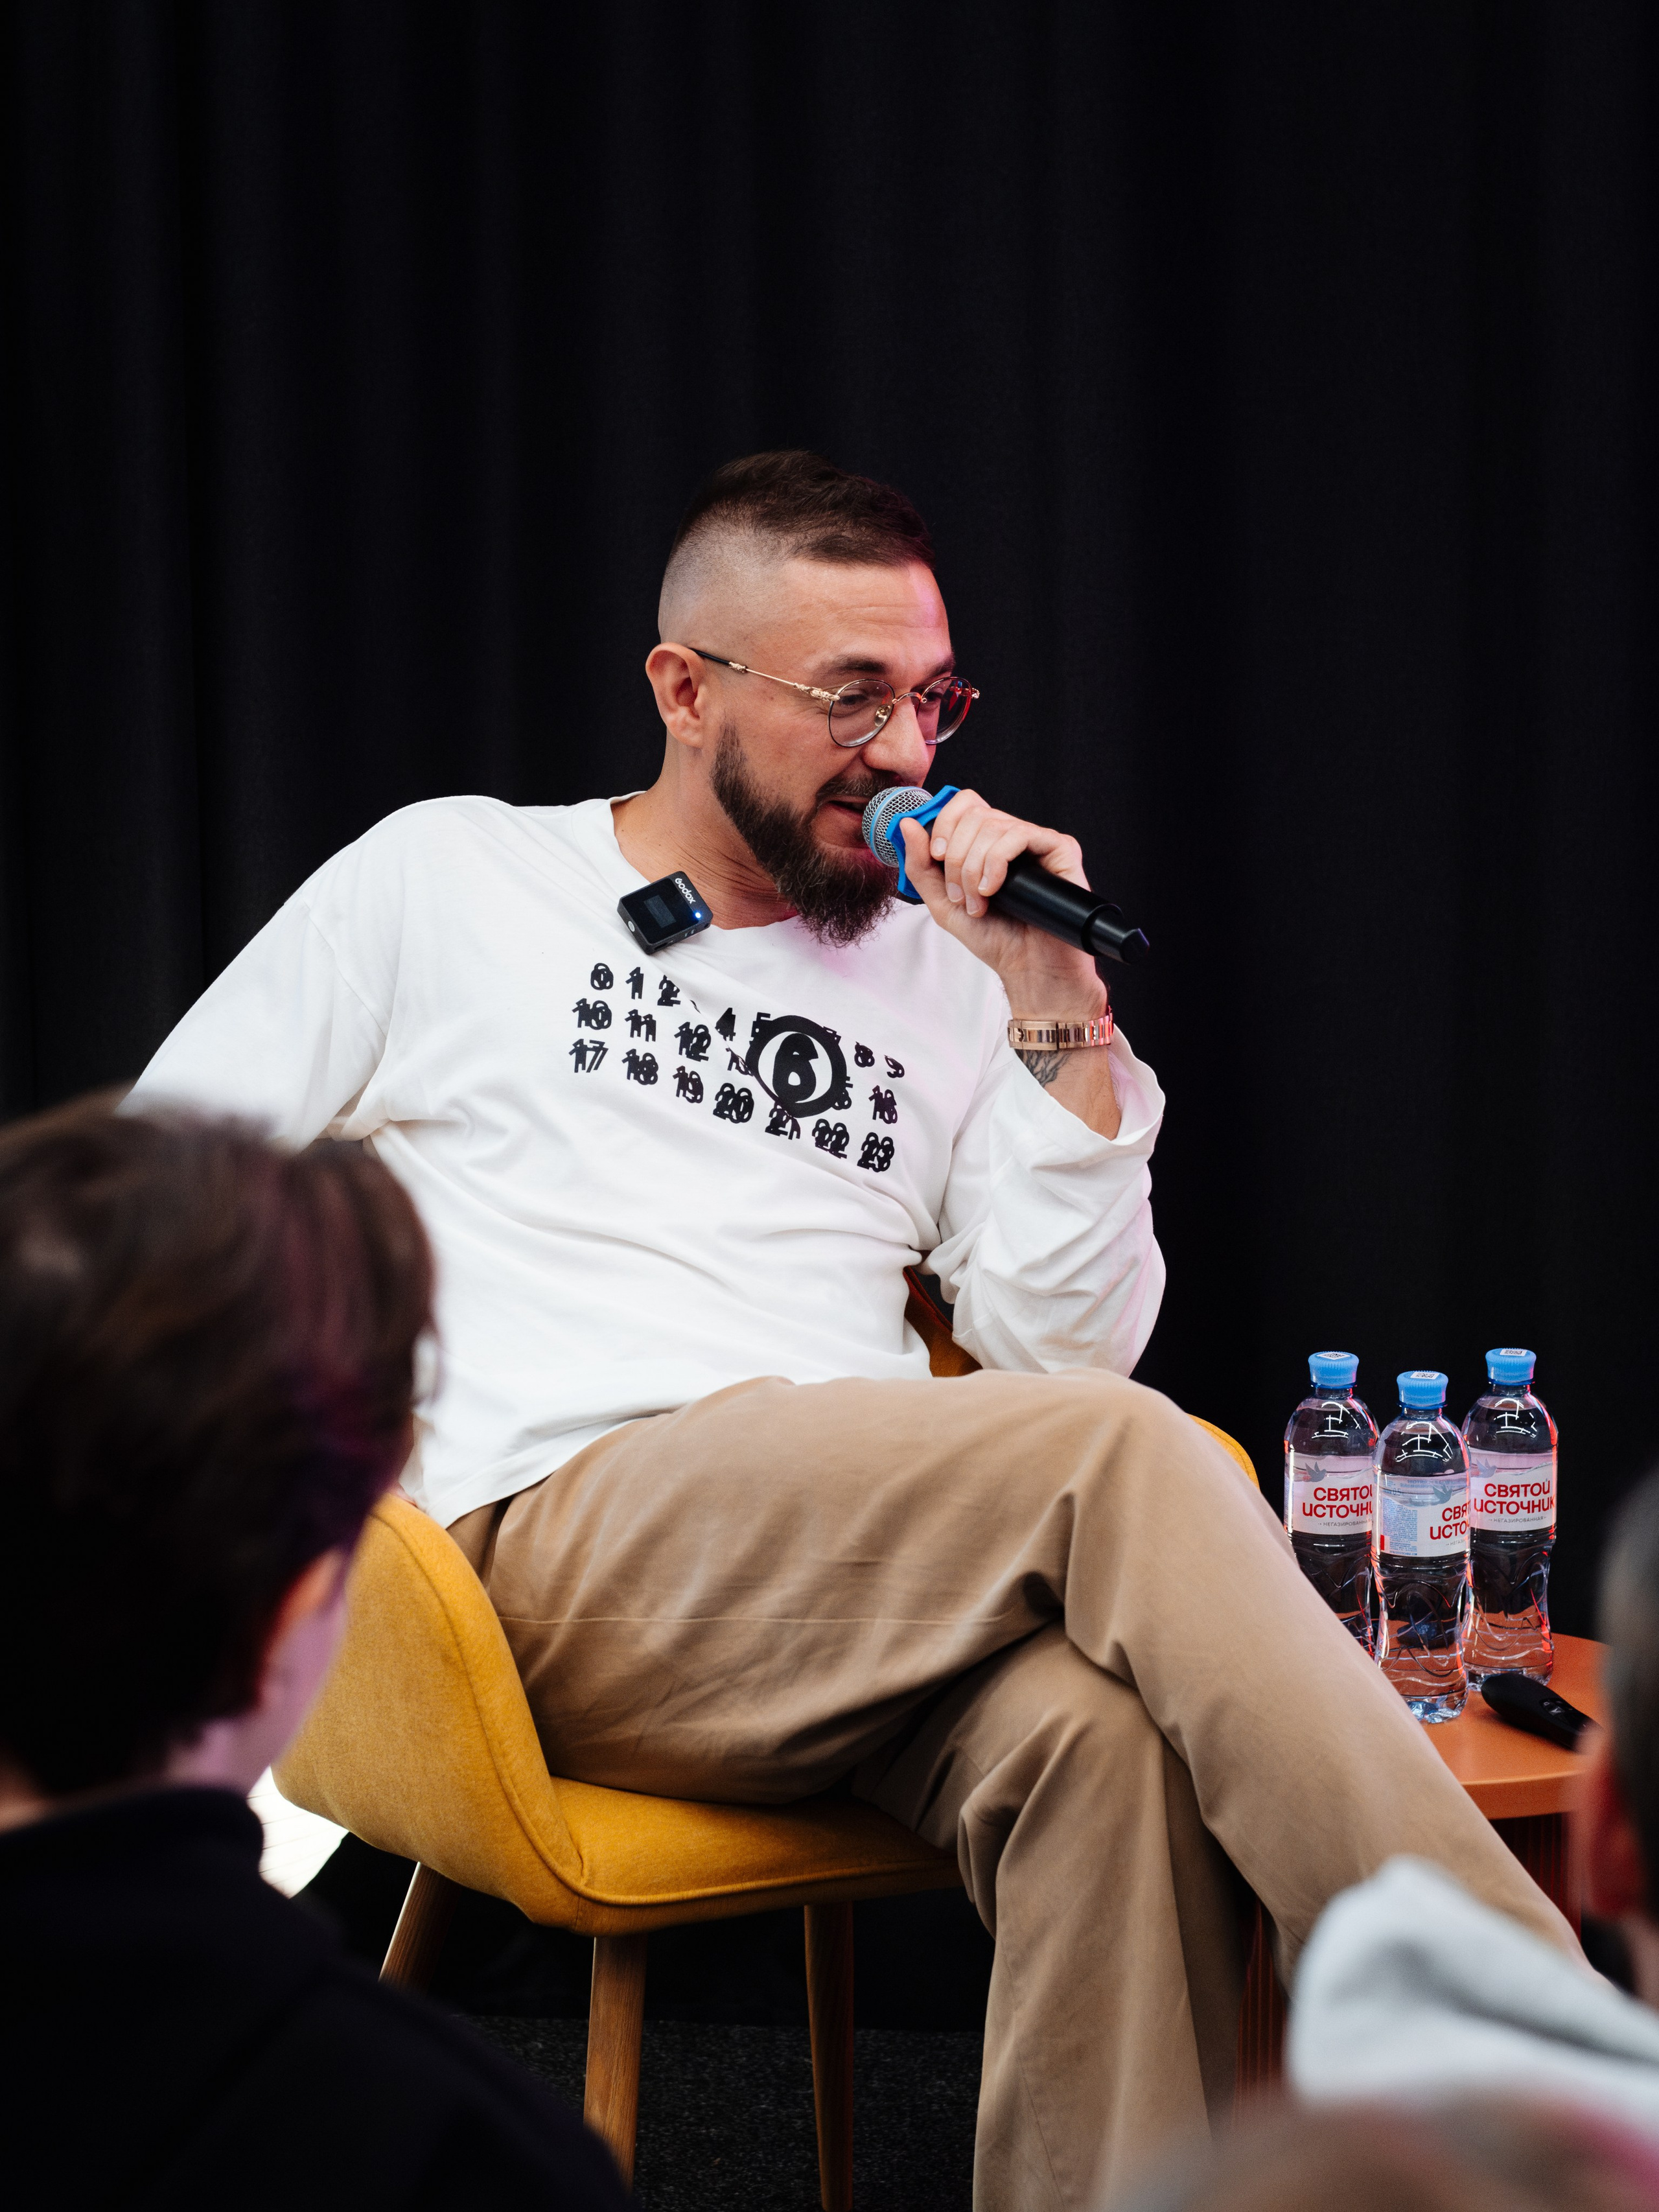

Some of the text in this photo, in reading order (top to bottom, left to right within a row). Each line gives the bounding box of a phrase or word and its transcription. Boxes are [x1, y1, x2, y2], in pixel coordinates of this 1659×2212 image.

[675, 878, 696, 904] Godox
[572, 998, 612, 1030] 10
[625, 1008, 656, 1042] 11
[674, 1021, 712, 1062] 12
[590, 962, 614, 990] 0
[625, 966, 644, 1000] 1
[657, 974, 681, 1007] 2
[715, 1008, 736, 1042] 4
[772, 1032, 819, 1103] 6
[854, 1041, 876, 1068] 8
[568, 1038, 609, 1073] 17
[621, 1048, 659, 1086] 18
[672, 1065, 704, 1104] 19
[712, 1082, 754, 1124] 20
[811, 1118, 850, 1159] 22
[857, 1132, 895, 1173] 23
[1474, 1495, 1555, 1515] ИСТОЧНИК
[1484, 1478, 1550, 1498] СВЯТОЙ
